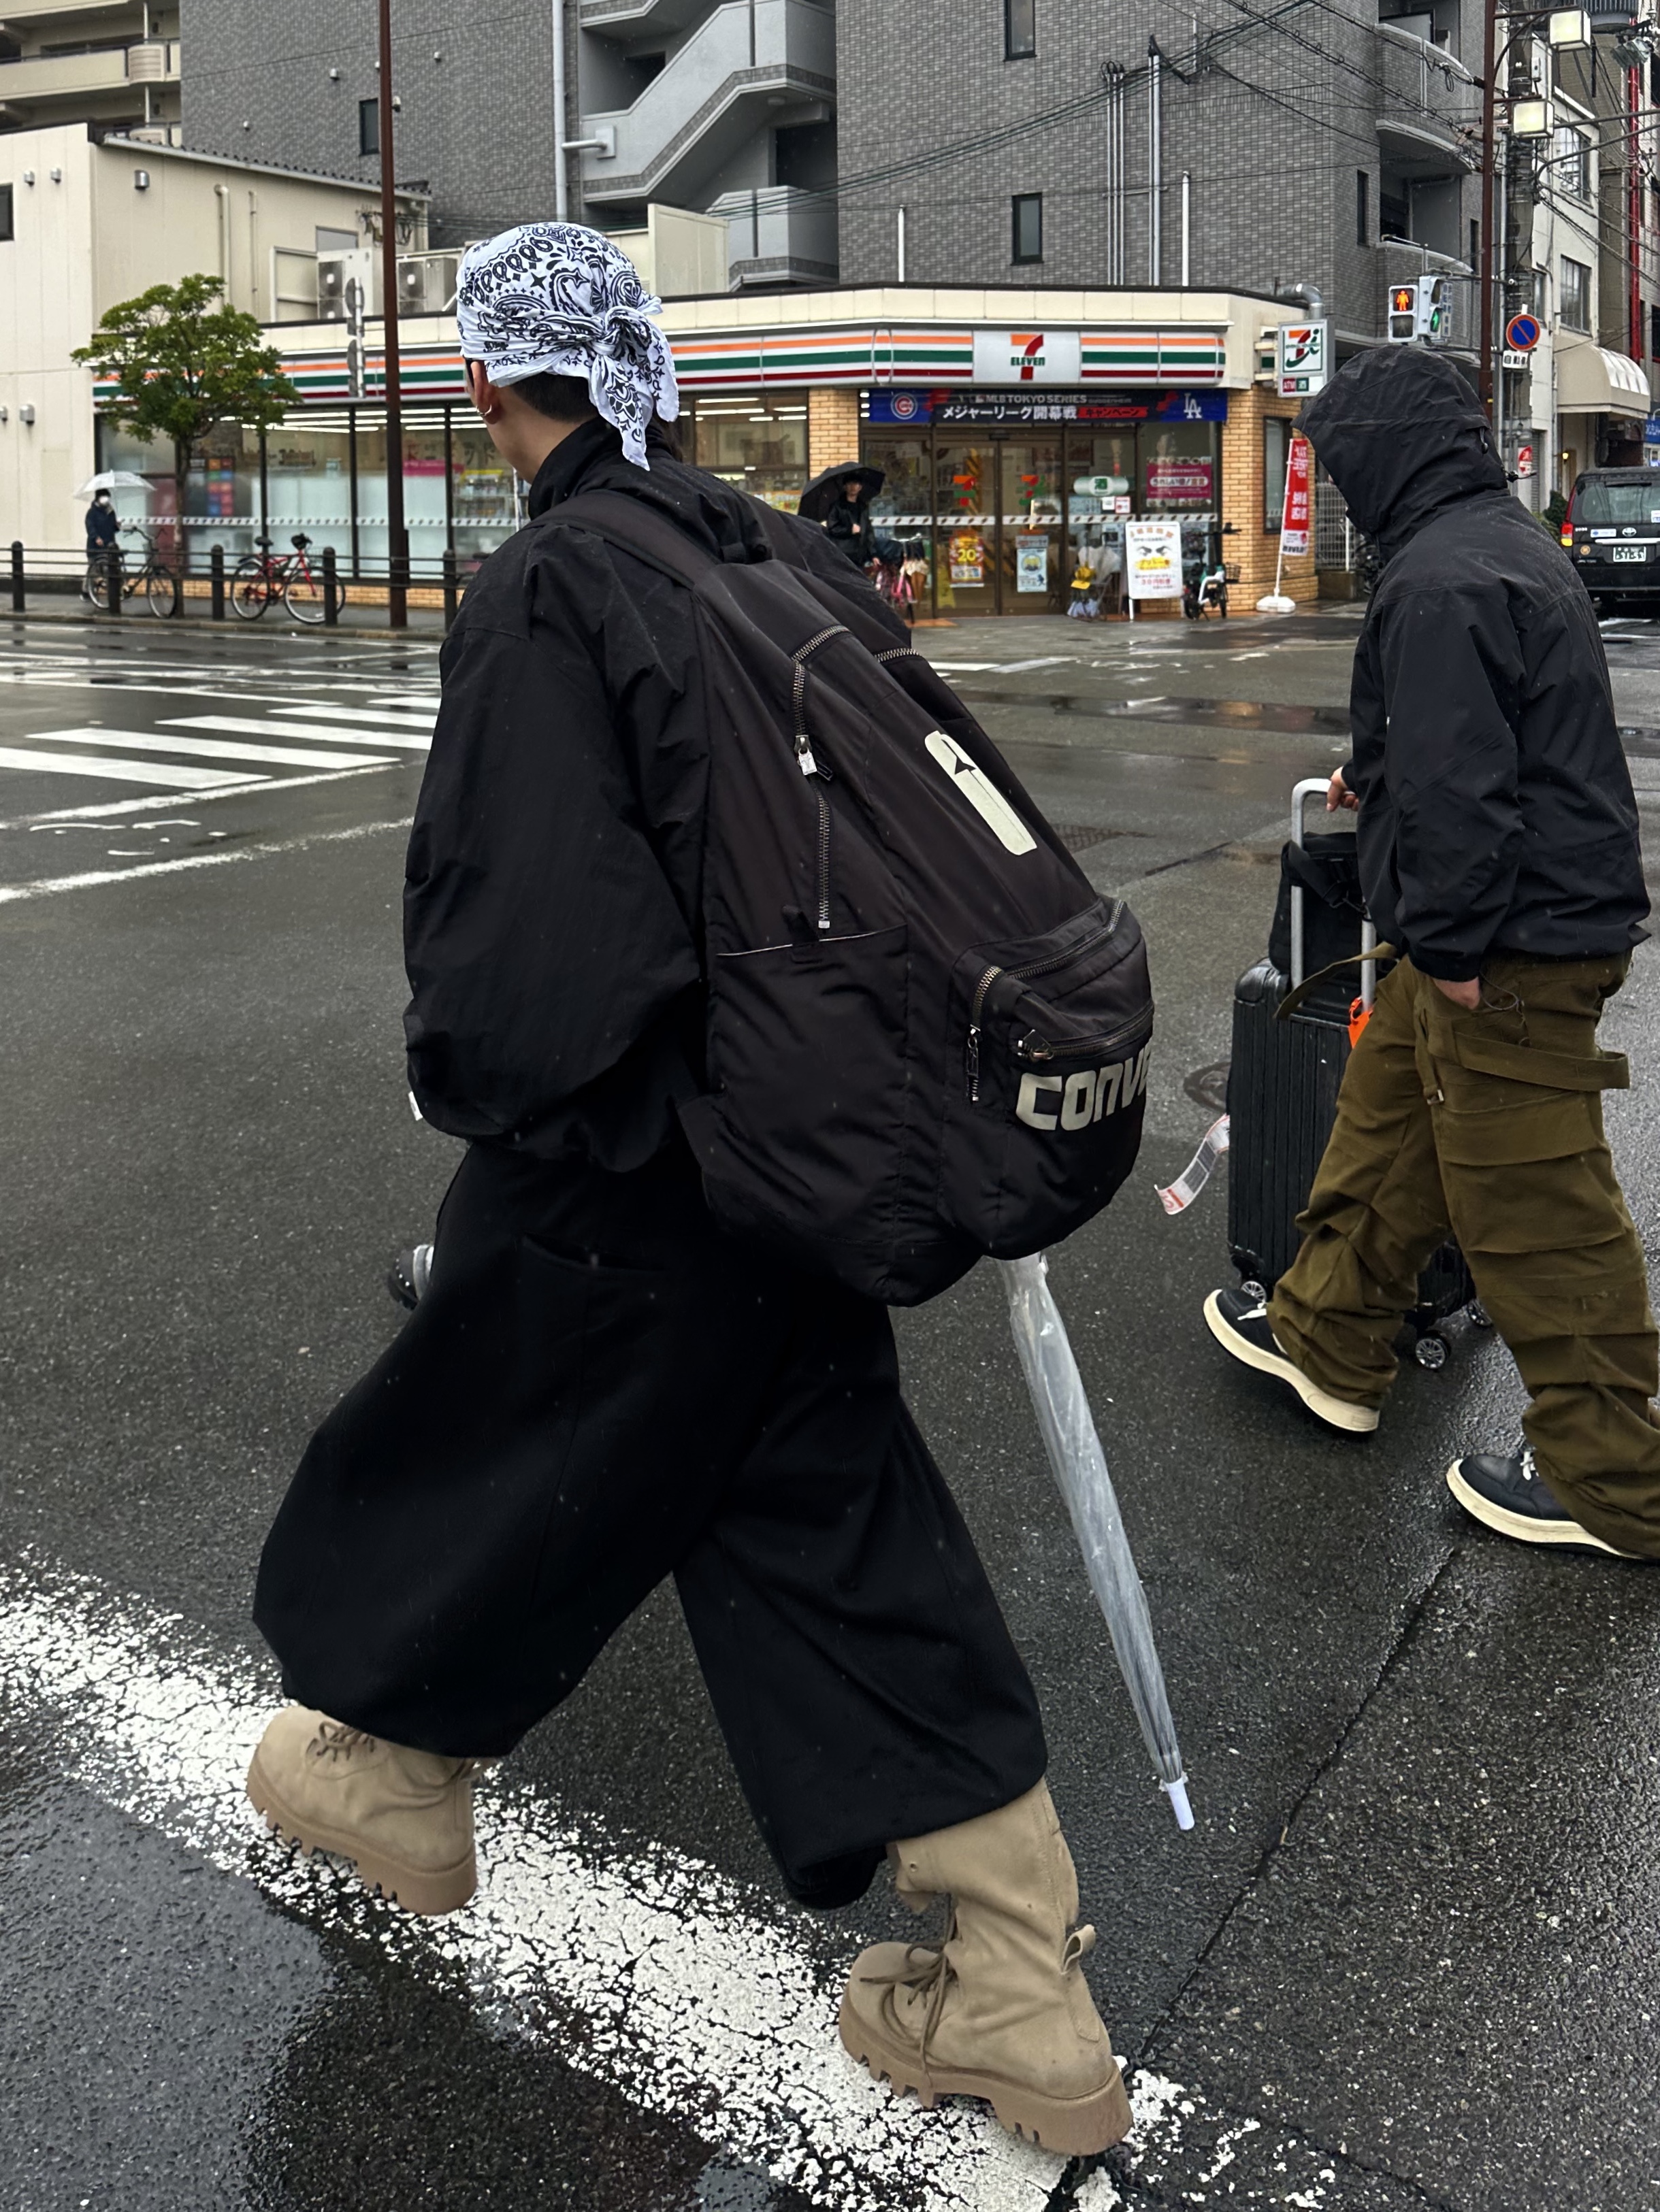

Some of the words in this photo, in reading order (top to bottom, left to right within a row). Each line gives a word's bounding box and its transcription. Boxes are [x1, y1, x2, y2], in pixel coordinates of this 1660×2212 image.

[986, 395, 1006, 403] MLB
[1007, 395, 1045, 403] TOKYO
[1046, 394, 1087, 403] SERIES
[942, 405, 1077, 420] メジャーリーグ開幕戦
[1085, 408, 1141, 417] キャンペーン
[958, 548, 977, 563] 20
